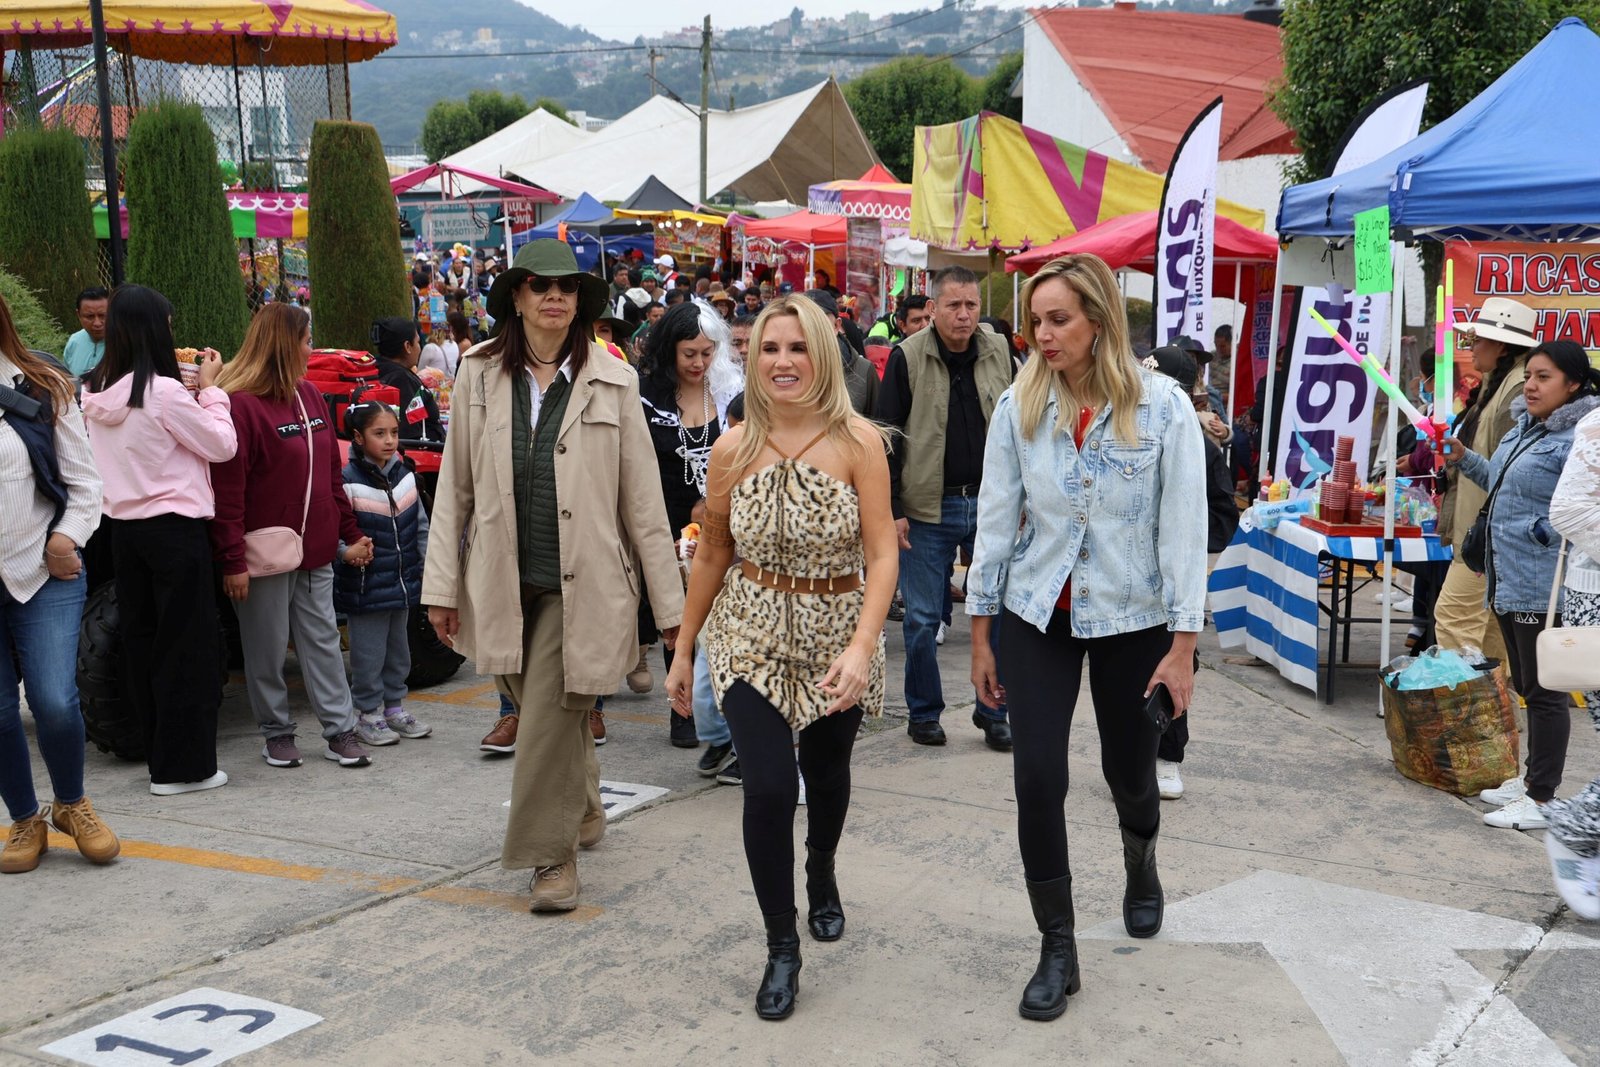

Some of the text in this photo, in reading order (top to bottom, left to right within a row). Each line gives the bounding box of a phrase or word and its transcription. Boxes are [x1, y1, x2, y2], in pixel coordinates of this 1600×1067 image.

[1188, 188, 1208, 332] DE HUIXQUIL
[1357, 258, 1373, 283] $15
[1474, 253, 1600, 296] RICAS
[1356, 331, 1370, 355] DE
[1285, 291, 1369, 490] agu
[277, 418, 324, 433] TACMA
[95, 1003, 276, 1066] 13
